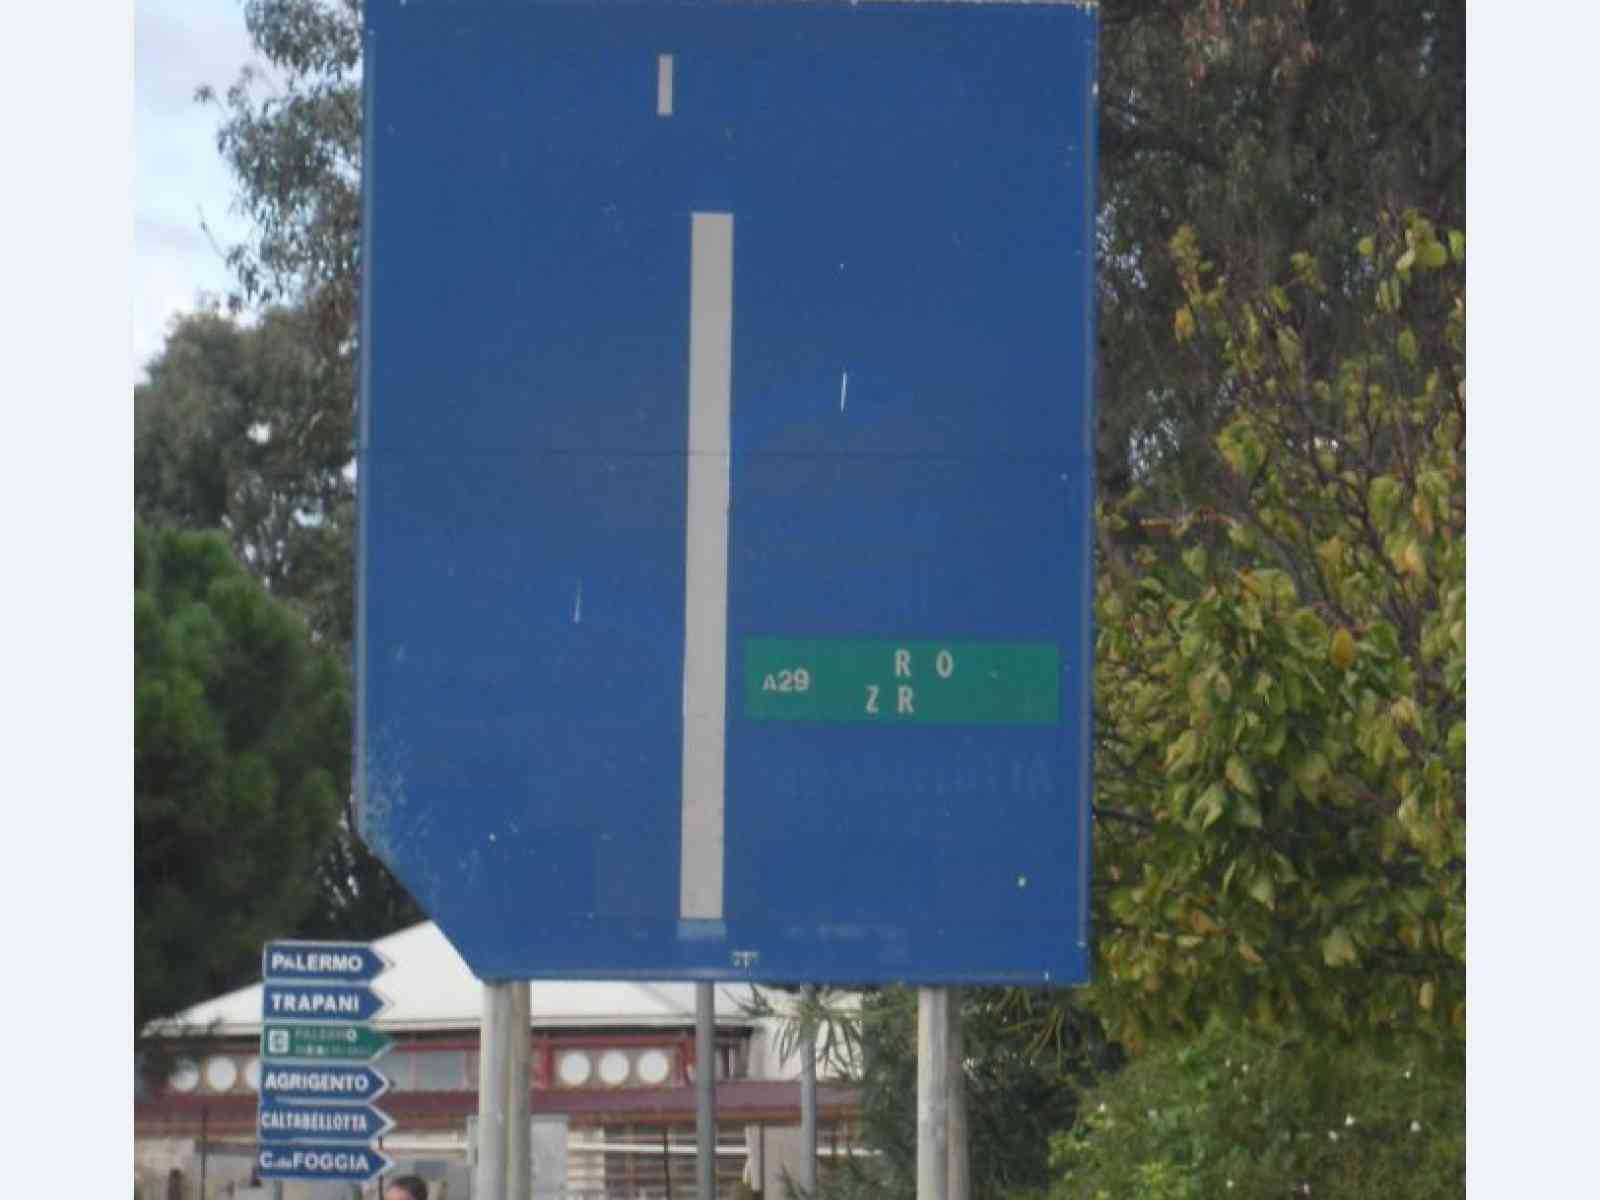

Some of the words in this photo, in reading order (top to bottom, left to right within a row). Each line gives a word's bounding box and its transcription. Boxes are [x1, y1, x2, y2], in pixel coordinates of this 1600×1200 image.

[271, 952, 363, 972] PALERMO
[272, 993, 360, 1012] TRAPANI
[265, 1072, 369, 1091] AGRIGENTO
[261, 1111, 367, 1131] CALTABELLOTTA
